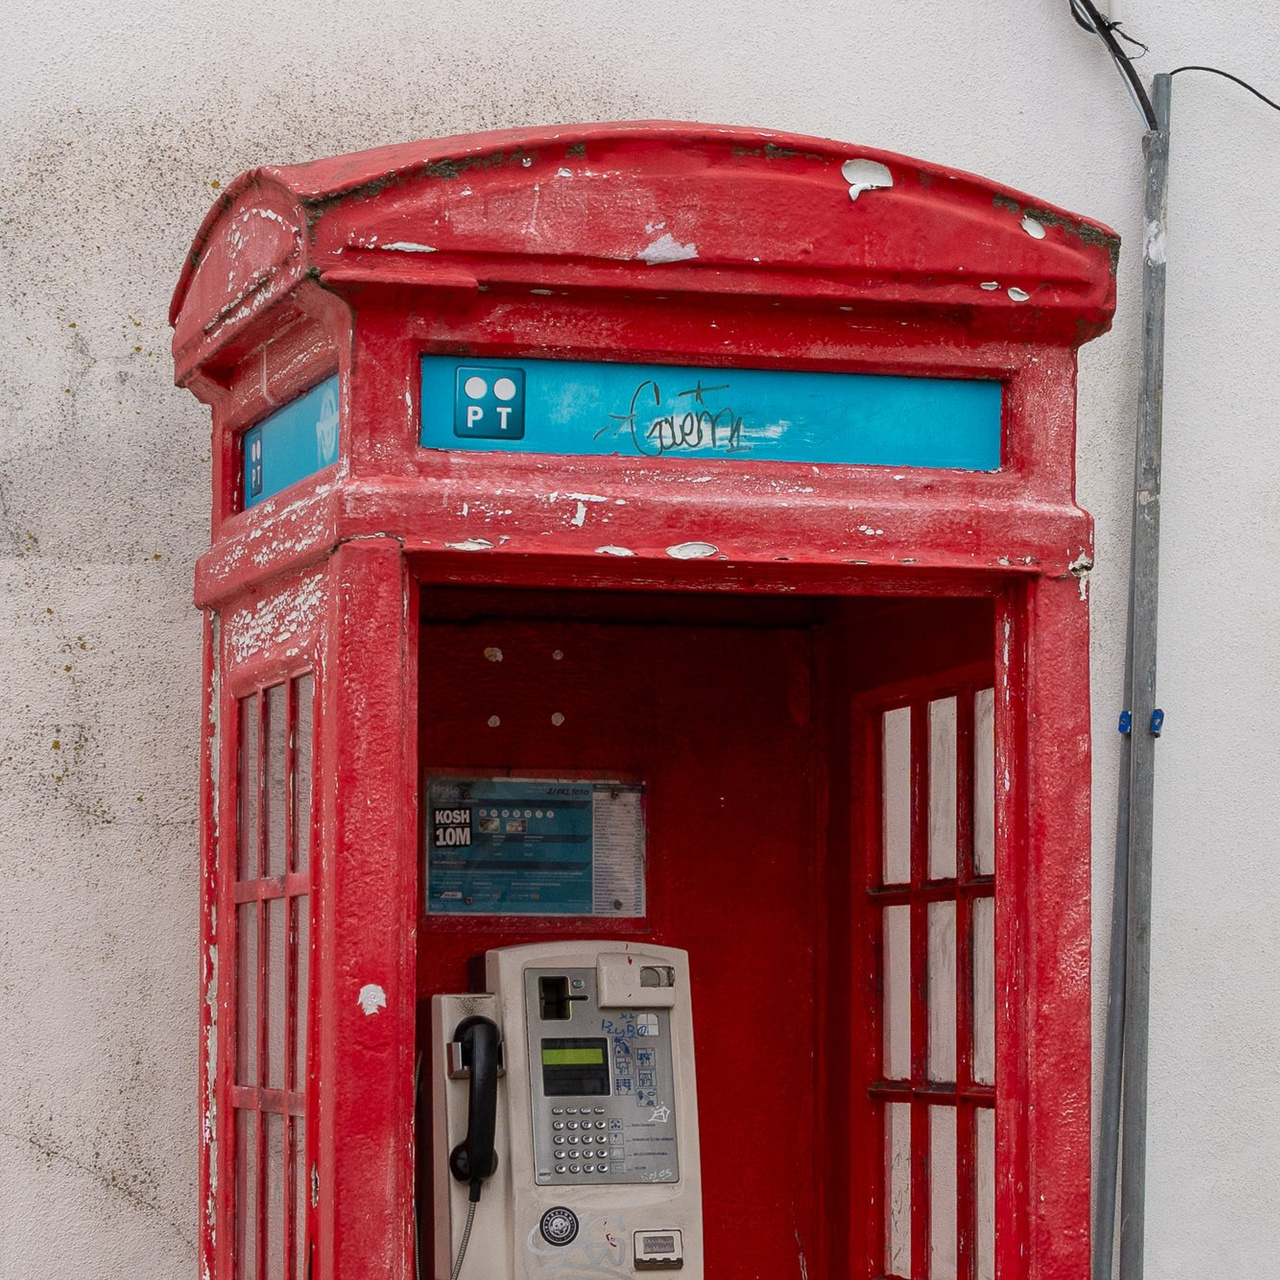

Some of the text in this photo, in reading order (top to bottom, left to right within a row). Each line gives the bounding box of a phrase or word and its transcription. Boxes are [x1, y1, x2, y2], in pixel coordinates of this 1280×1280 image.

[466, 406, 513, 429] PT
[251, 466, 261, 490] PT
[435, 809, 470, 825] KOSH
[436, 827, 471, 846] 10M
